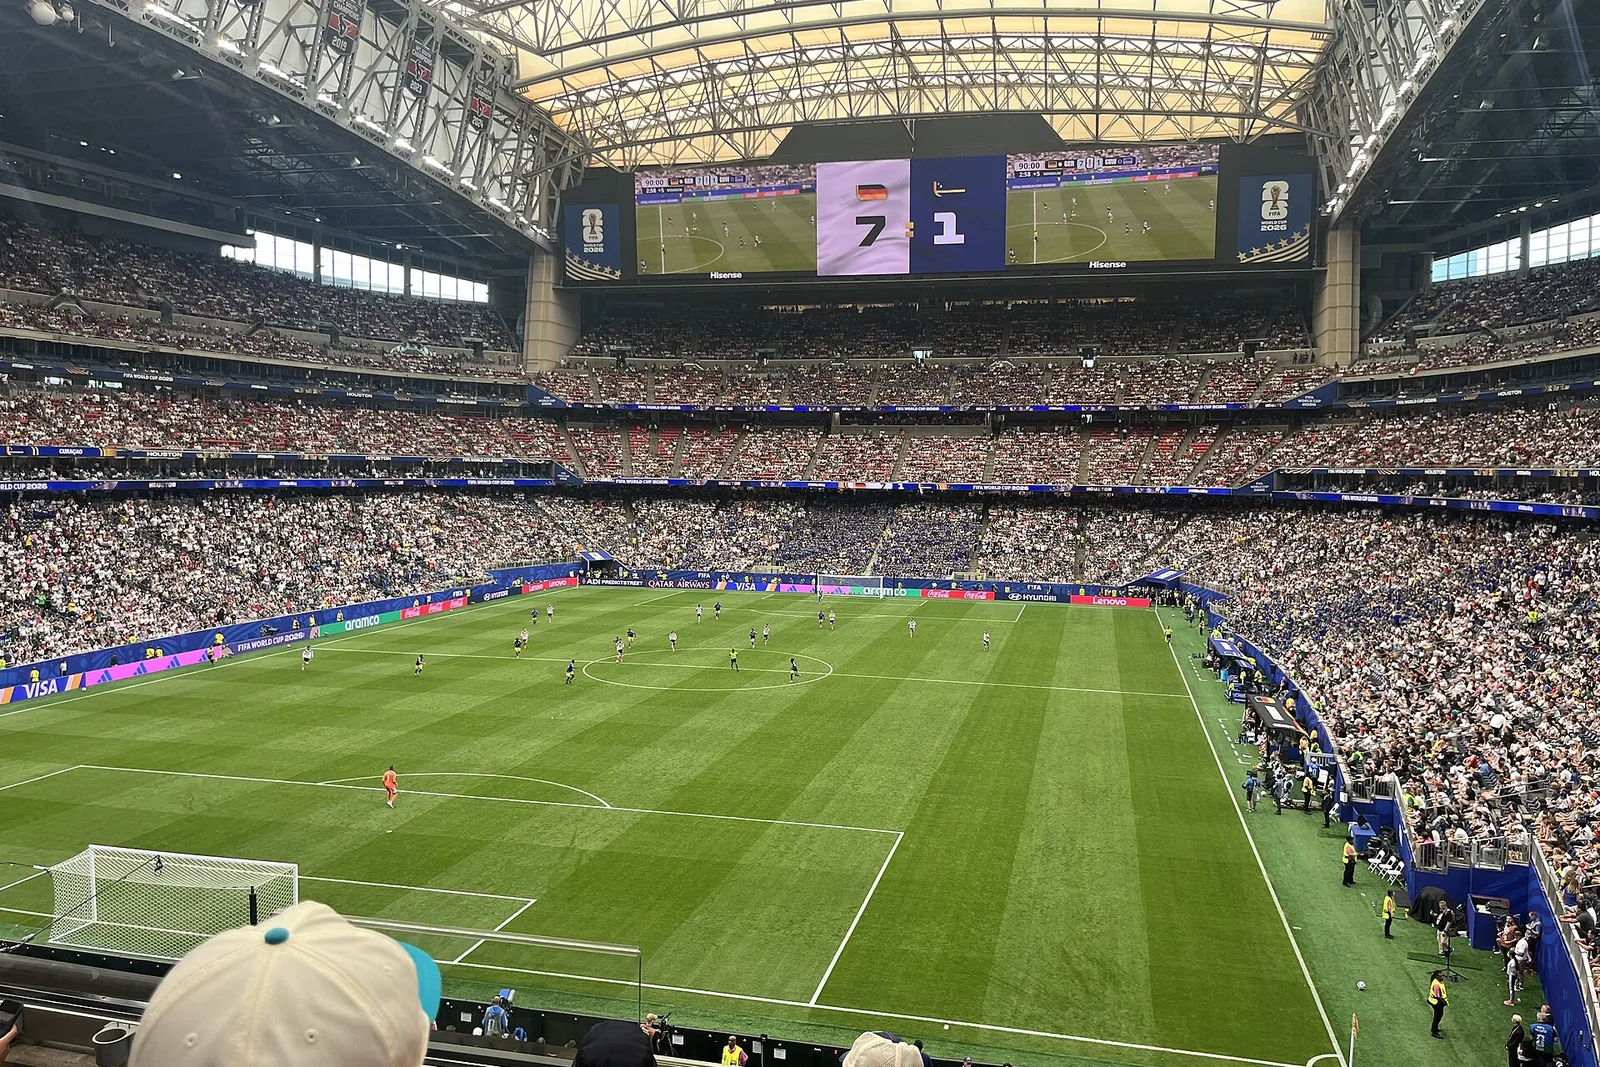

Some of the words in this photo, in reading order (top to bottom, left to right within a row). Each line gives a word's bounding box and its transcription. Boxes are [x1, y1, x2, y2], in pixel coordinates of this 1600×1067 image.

[332, 36, 348, 51] 2019
[856, 216, 886, 247] 7
[934, 212, 964, 244] 1
[648, 580, 674, 588] QATAR
[863, 587, 907, 596] aramco
[1092, 595, 1126, 605] Lenovo
[345, 615, 380, 631] aramco
[252, 638, 272, 648] WORLD
[273, 636, 284, 645] CUP
[285, 632, 303, 642] 2026
[22, 679, 58, 699] VISA
